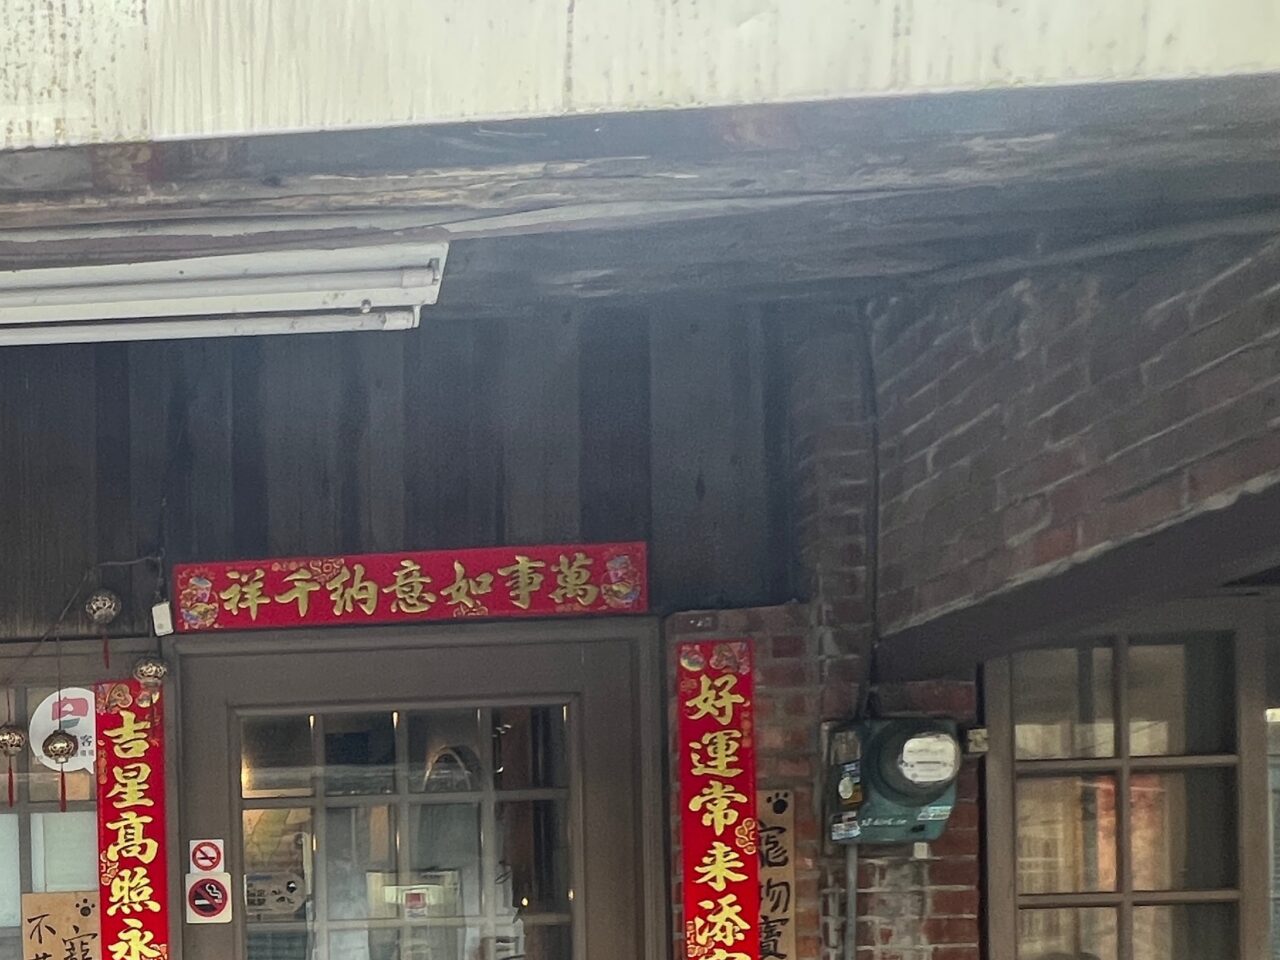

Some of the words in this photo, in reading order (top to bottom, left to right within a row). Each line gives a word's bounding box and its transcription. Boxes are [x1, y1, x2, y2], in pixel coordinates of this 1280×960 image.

[219, 553, 603, 621] 萬事如意納千祥
